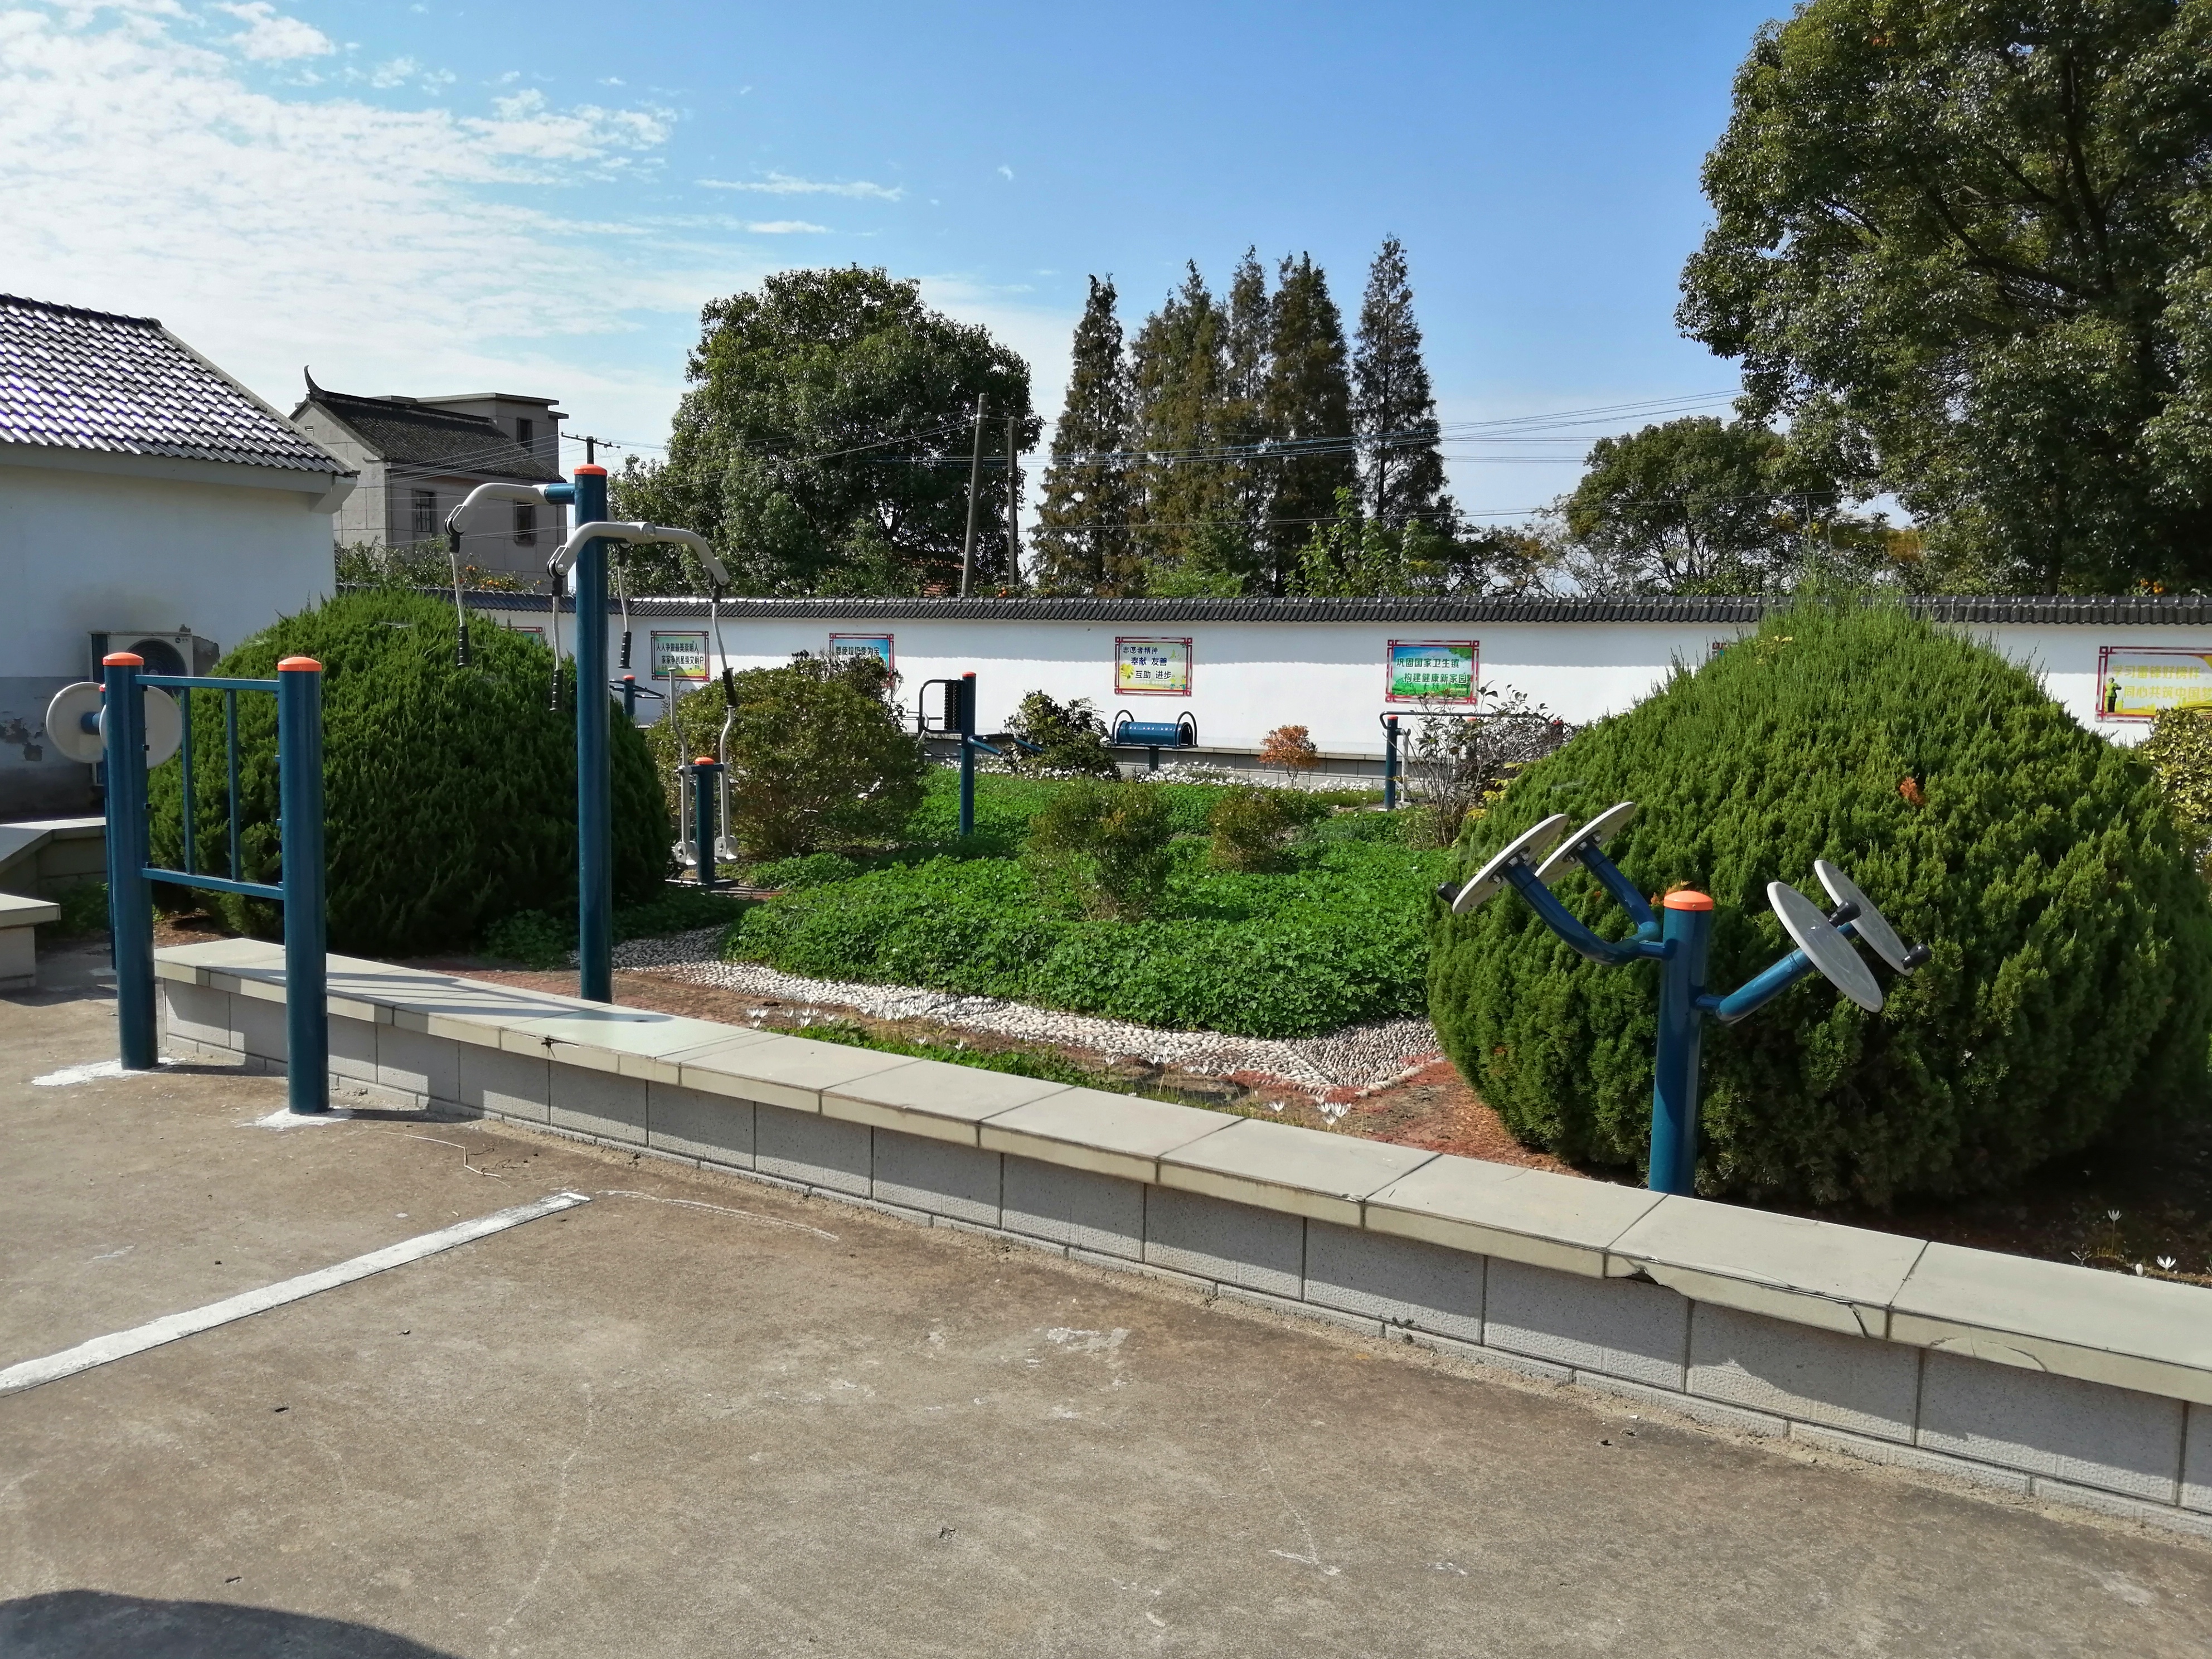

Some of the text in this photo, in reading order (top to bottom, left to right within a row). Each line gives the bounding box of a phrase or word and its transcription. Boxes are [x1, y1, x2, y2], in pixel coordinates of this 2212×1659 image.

[1131, 657, 1167, 666] 奉献 友善
[1396, 658, 1459, 668] 巩固国家卫生镇
[1135, 671, 1171, 680] 互助 进步
[2112, 665, 2200, 680] 学习雷锋好榜样
[1404, 673, 1467, 685] 构建健康新家园
[2124, 686, 2212, 700] 同心共筑中国梦
